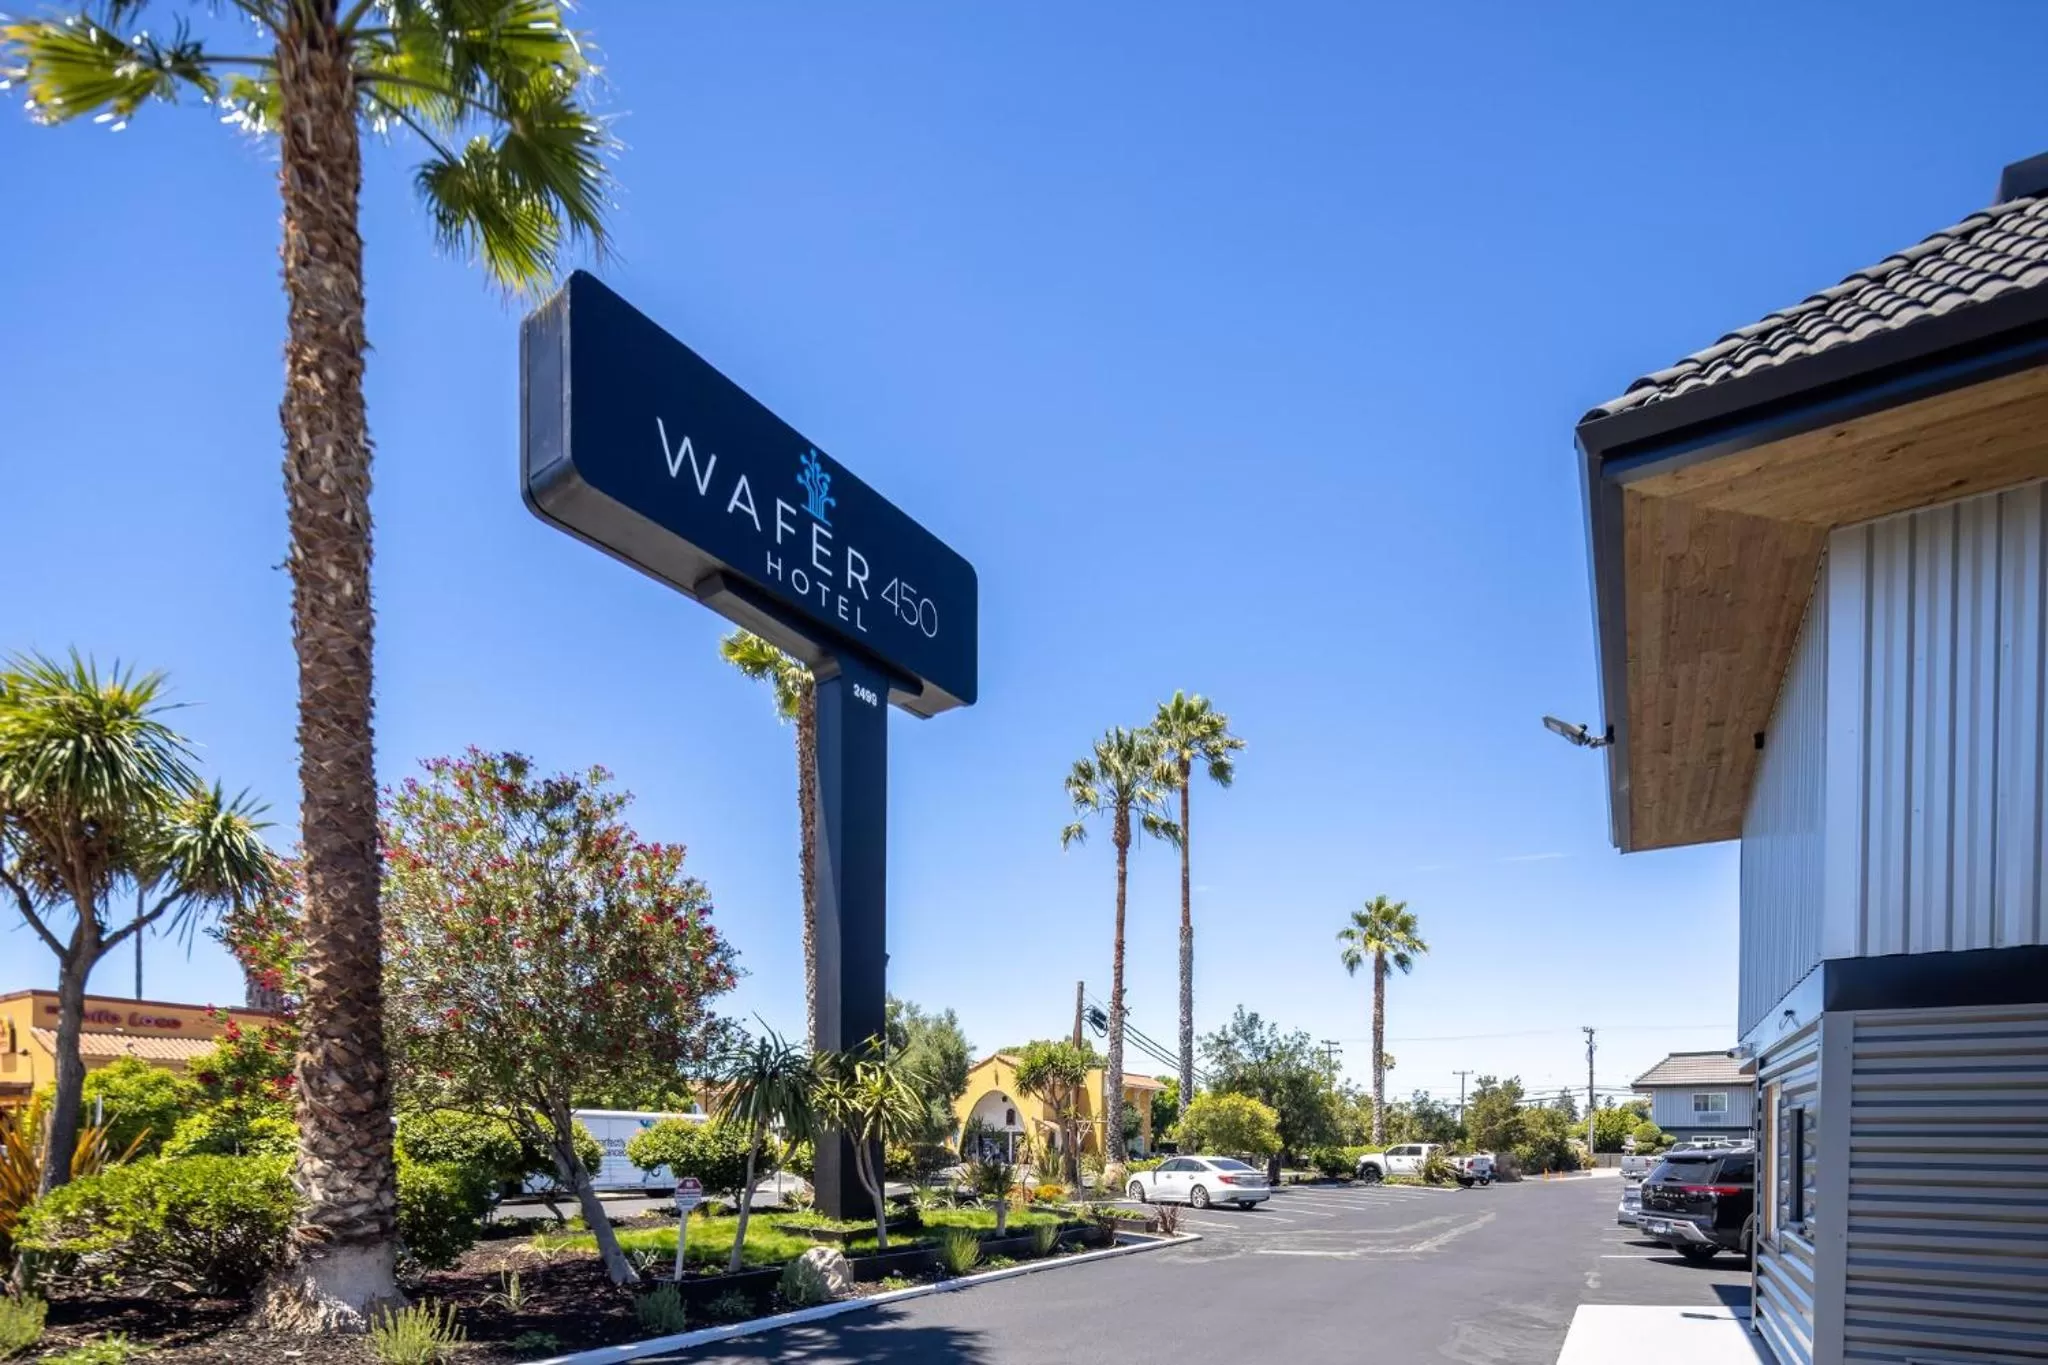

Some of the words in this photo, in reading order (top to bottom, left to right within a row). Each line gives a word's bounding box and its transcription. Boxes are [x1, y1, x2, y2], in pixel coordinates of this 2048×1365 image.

[656, 416, 870, 601] WAFER
[880, 576, 939, 638] 450
[766, 550, 868, 633] HOTEL
